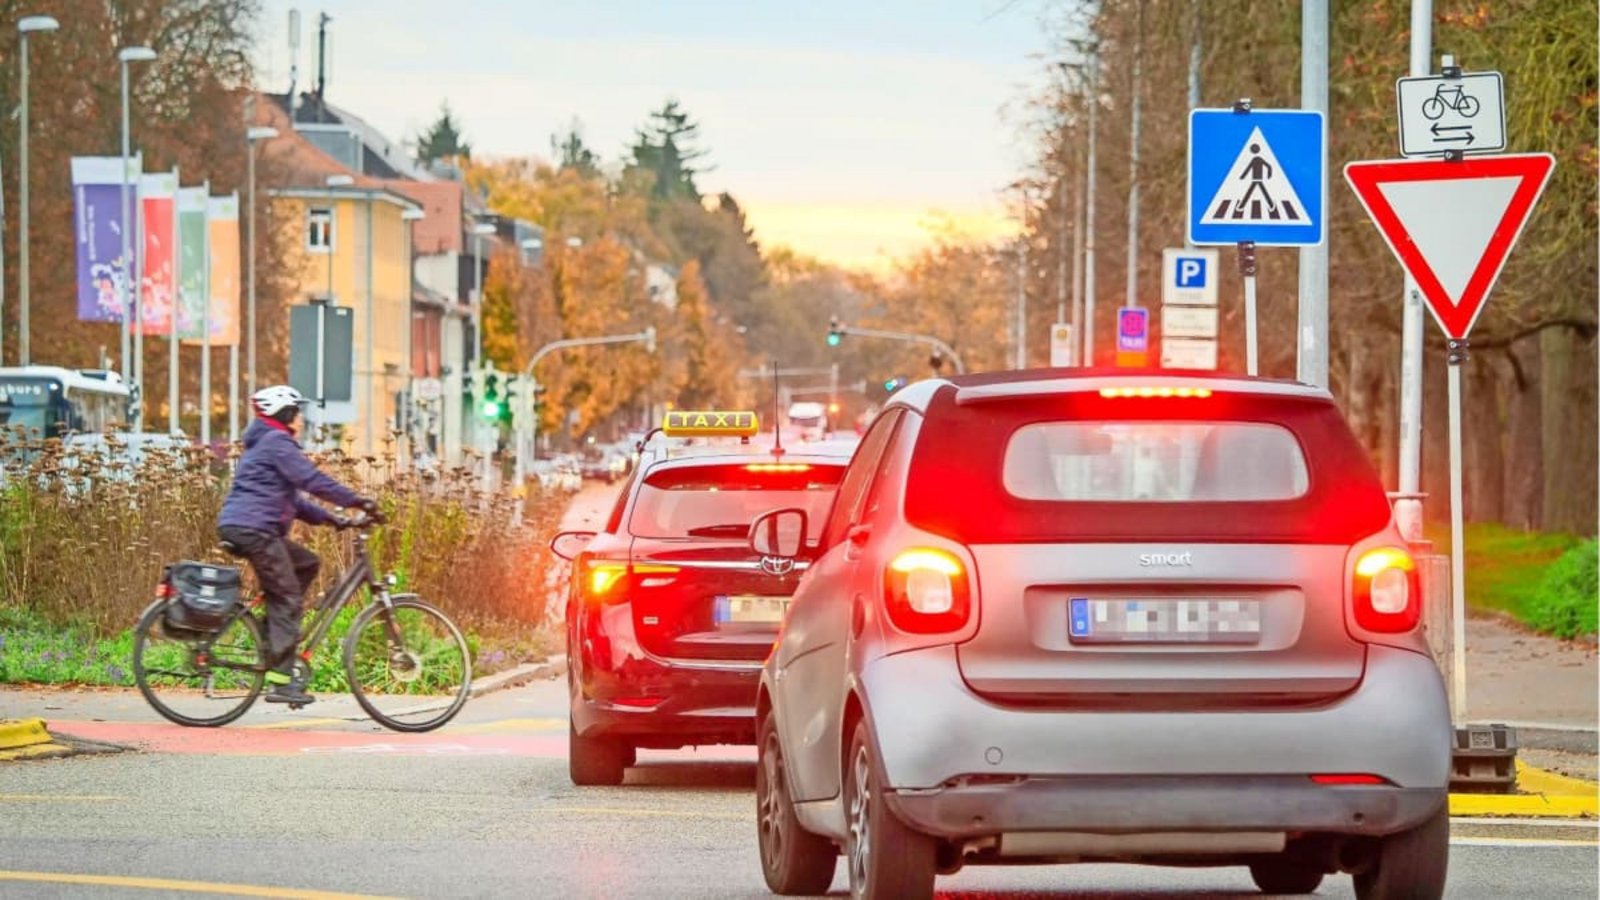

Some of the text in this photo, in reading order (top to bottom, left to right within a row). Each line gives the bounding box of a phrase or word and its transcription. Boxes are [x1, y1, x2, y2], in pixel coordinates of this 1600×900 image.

[1181, 260, 1200, 285] P
[678, 413, 740, 427] TAXI
[1139, 551, 1192, 567] smart
